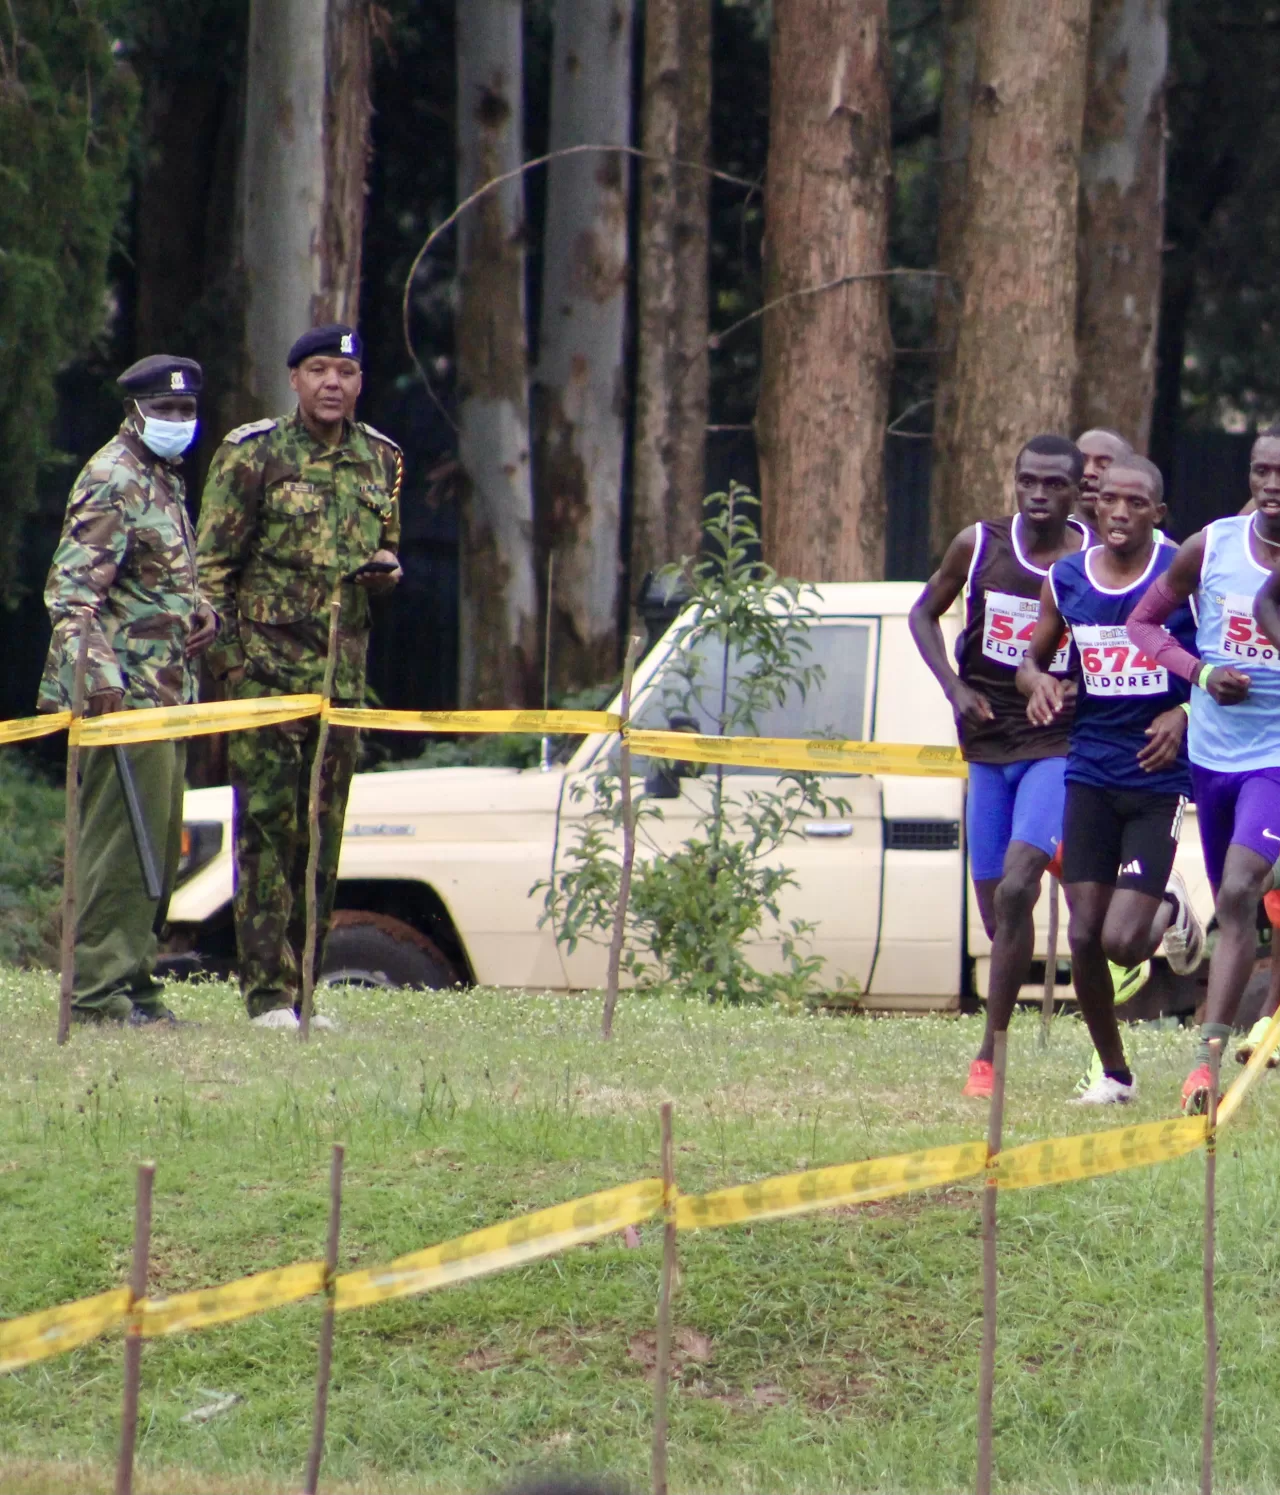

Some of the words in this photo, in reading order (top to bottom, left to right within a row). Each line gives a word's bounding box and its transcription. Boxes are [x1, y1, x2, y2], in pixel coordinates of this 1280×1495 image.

[1100, 628, 1128, 640] Betik
[986, 638, 1067, 665] ELDET
[1082, 646, 1159, 674] 674
[1085, 673, 1162, 688] ELDORET
